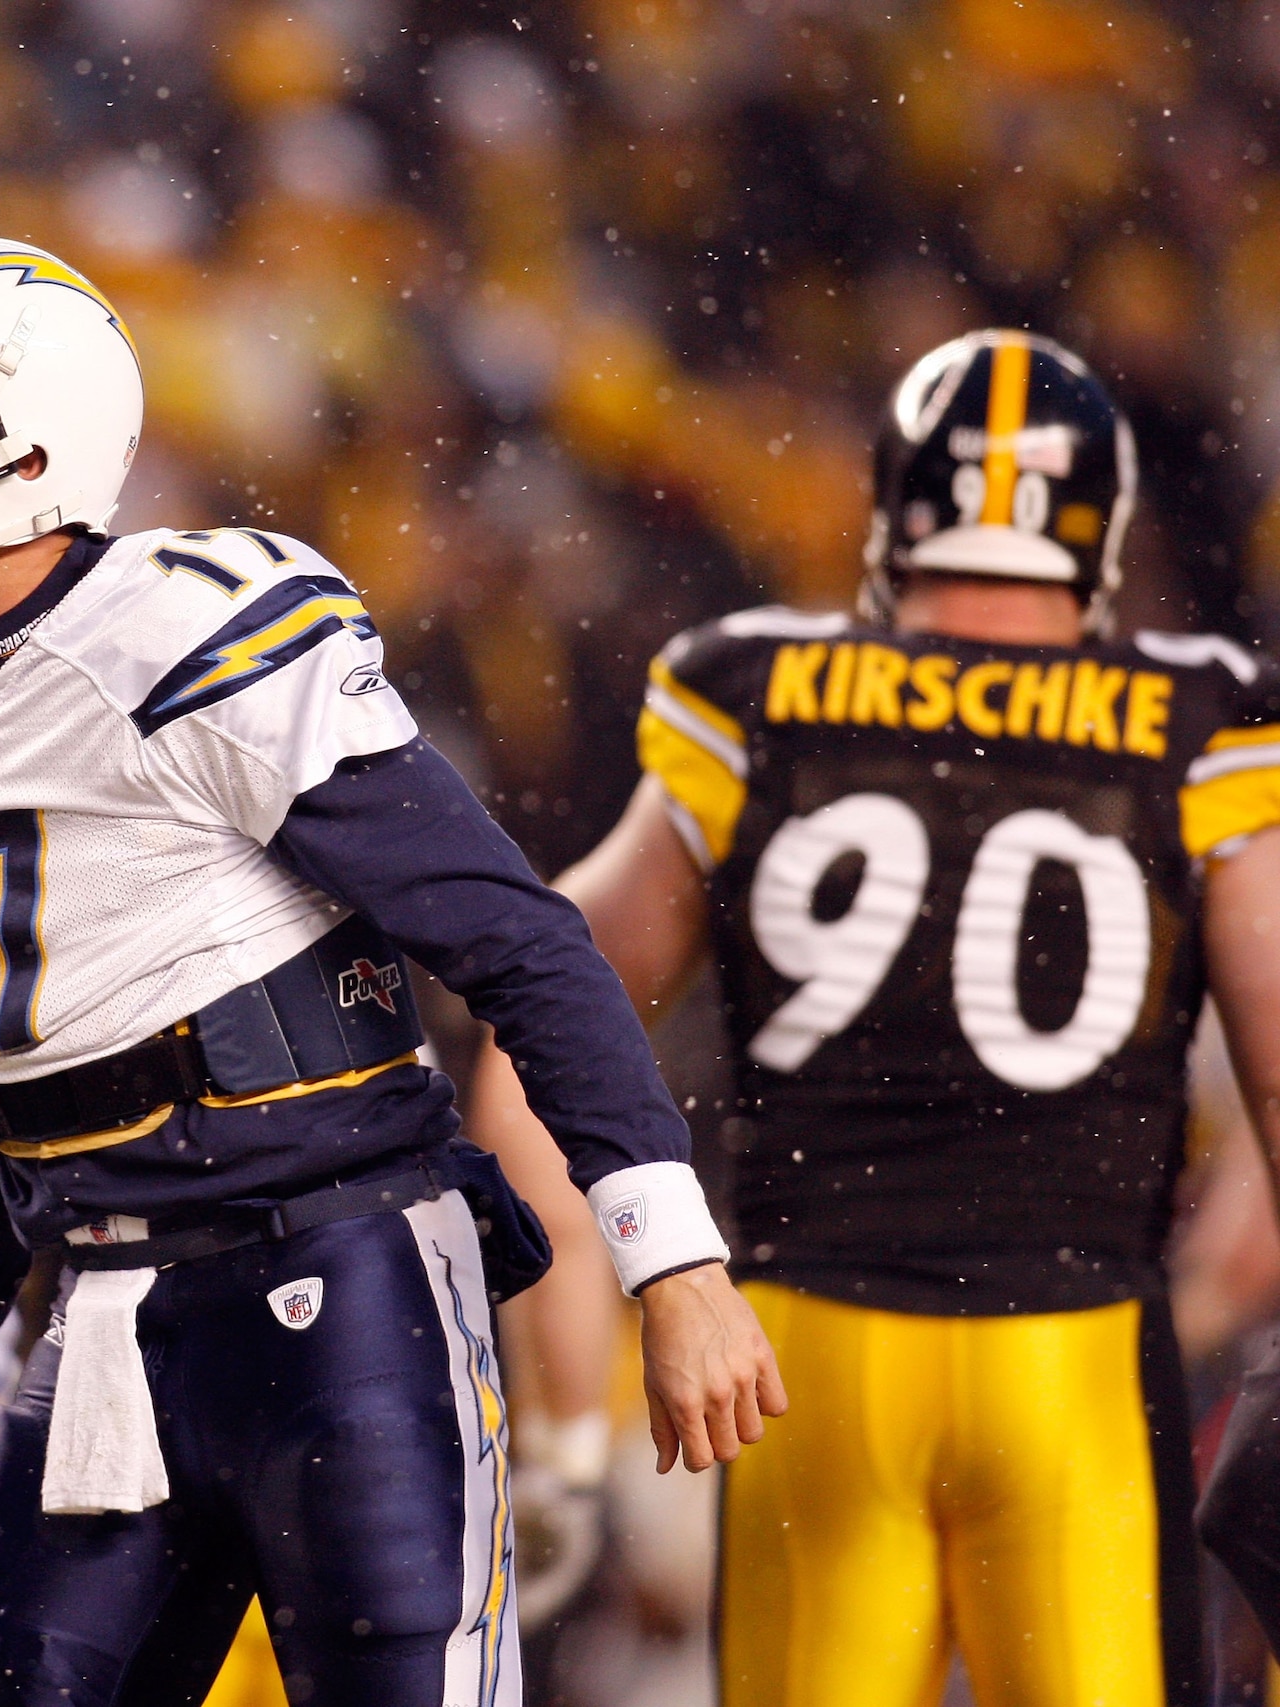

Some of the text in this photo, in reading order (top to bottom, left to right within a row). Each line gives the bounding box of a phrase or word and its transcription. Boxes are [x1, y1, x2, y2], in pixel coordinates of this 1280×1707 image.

[951, 462, 1050, 532] 90
[147, 527, 297, 601] 17
[765, 641, 1174, 760] KIRSCHKE
[748, 792, 1151, 1092] 90
[287, 1302, 312, 1321] NFL
